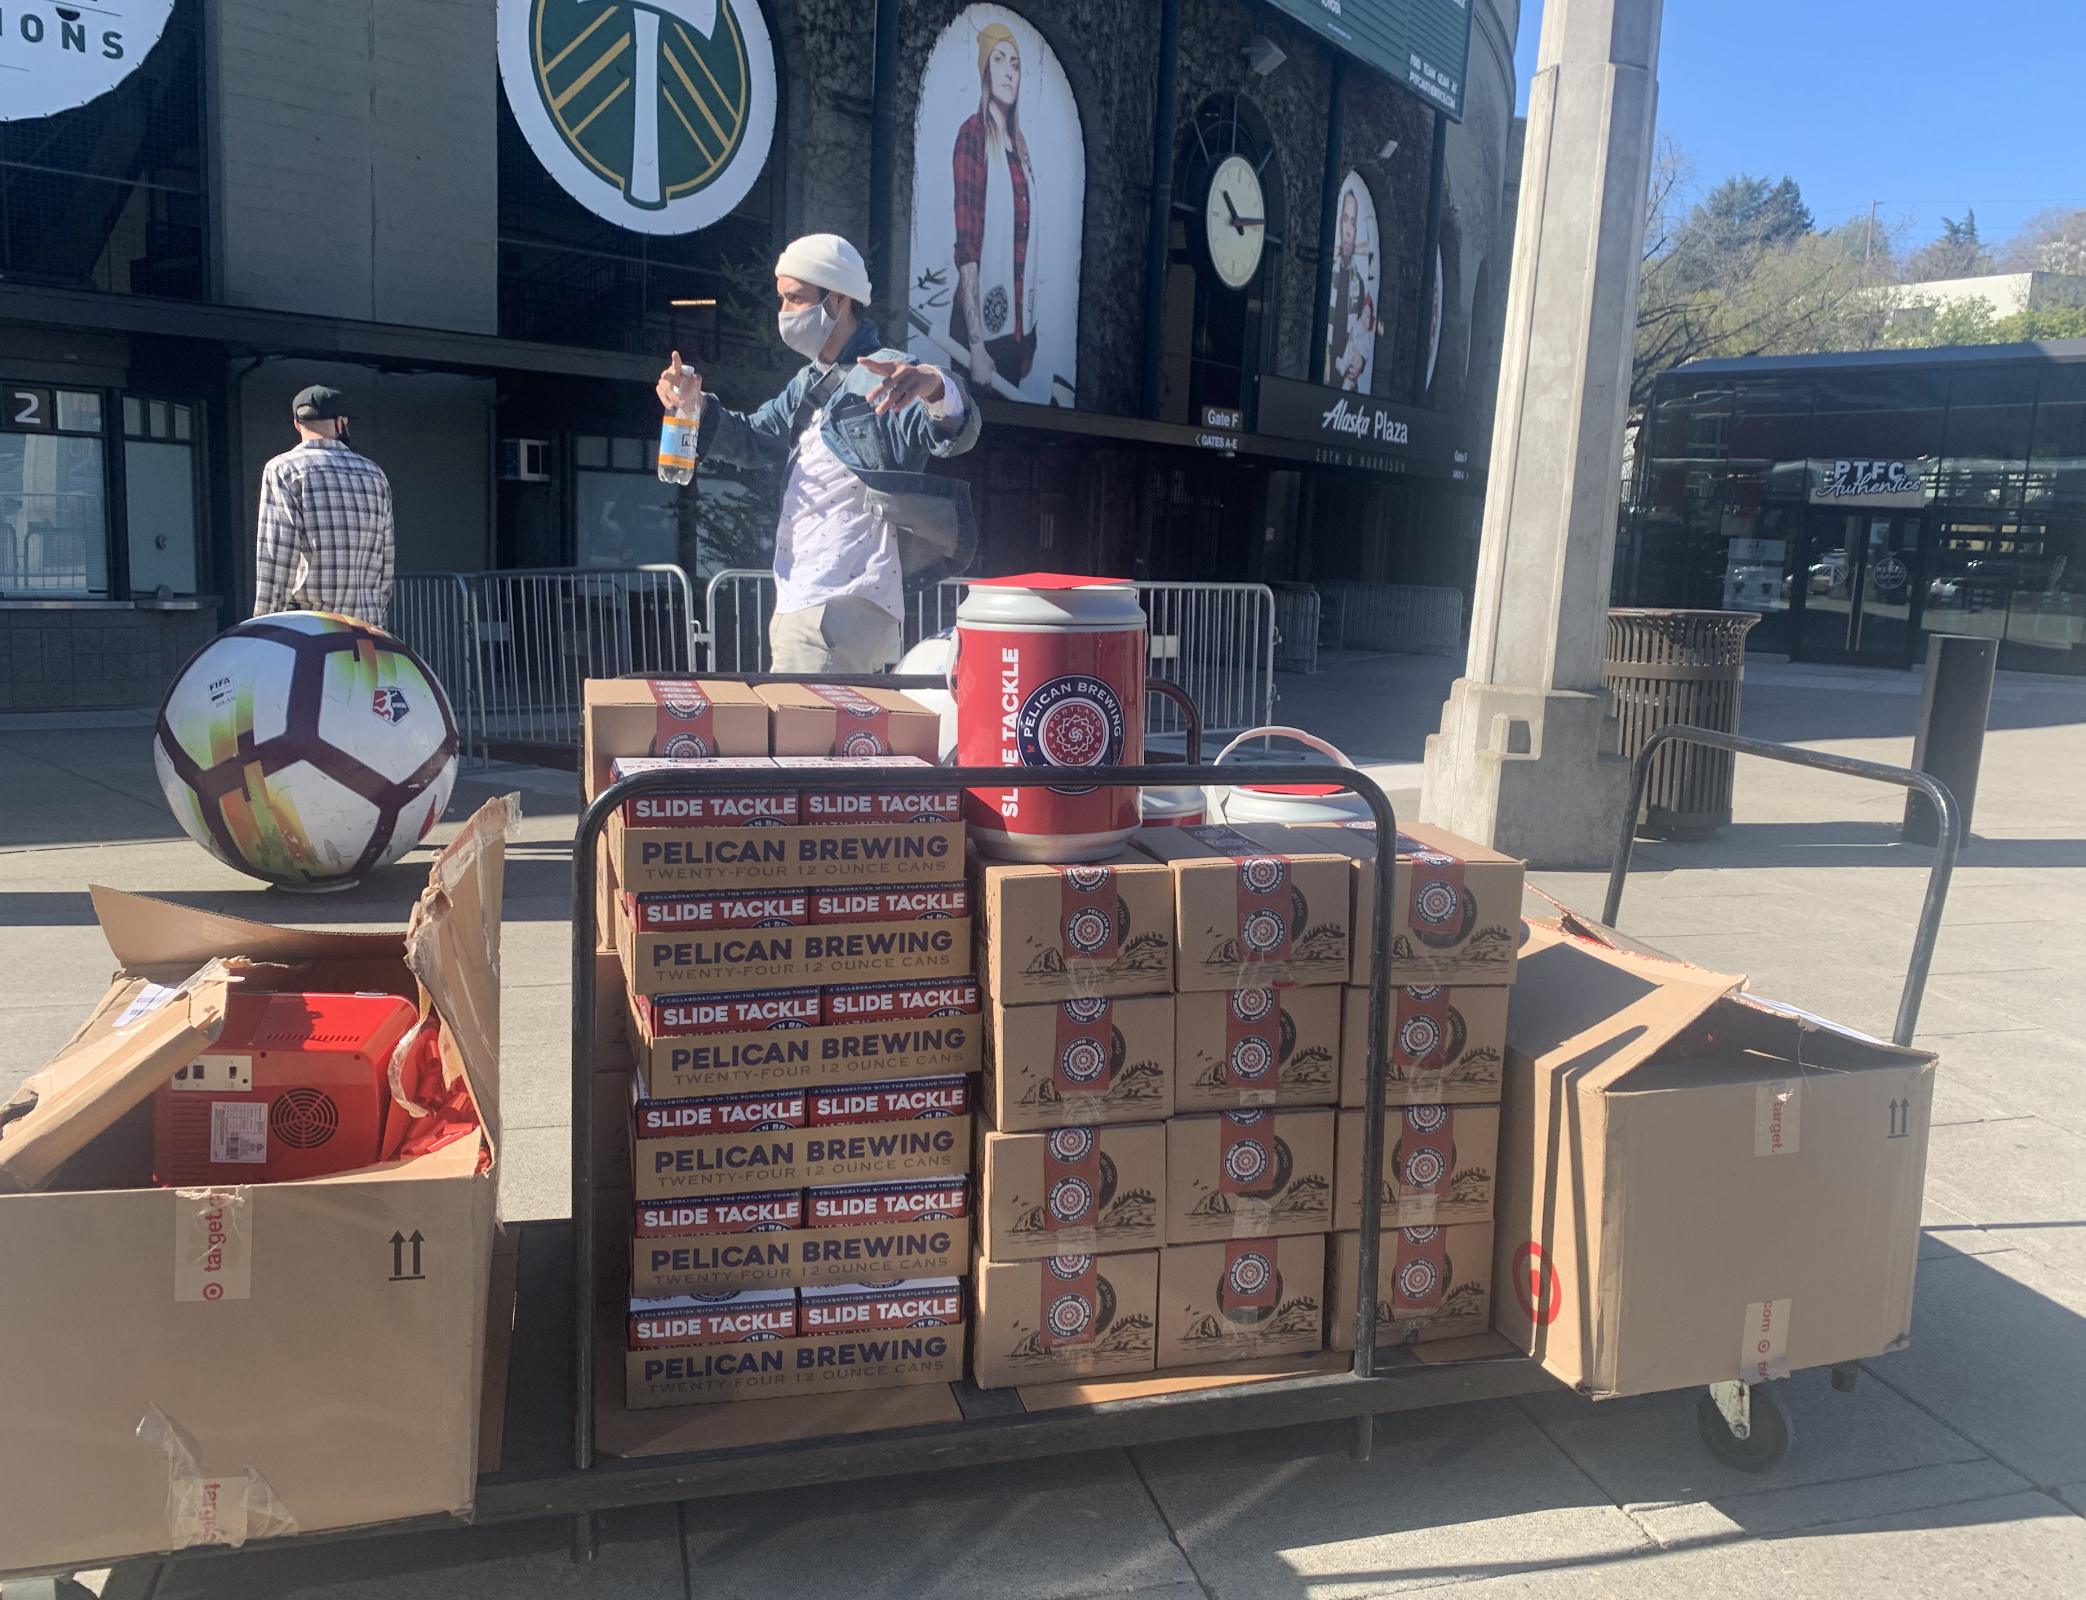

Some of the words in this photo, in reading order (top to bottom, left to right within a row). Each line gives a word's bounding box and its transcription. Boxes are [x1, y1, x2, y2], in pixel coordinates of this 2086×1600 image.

[1423, 62, 1436, 80] TEAM
[1437, 72, 1450, 89] GEAR
[15, 392, 41, 424] 2
[1207, 409, 1230, 427] Gate
[1230, 413, 1239, 428] F
[1322, 398, 1369, 439] Alaska
[1374, 411, 1408, 444] Plaza
[1201, 434, 1224, 448] GATES
[1224, 438, 1238, 449] A-E
[1316, 448, 1340, 465] 20TH
[1360, 455, 1405, 473] MORRISON
[1834, 460, 1904, 480] PTFC
[1816, 473, 1922, 497] Authentics
[210, 677, 231, 691] FIFA
[1002, 648, 1019, 741] TACKLE
[1023, 682, 1073, 738] PELICAN
[1077, 681, 1121, 737] BREWING
[1050, 706, 1101, 728] PORTLAND
[1050, 742, 1100, 764] THORNS
[1002, 749, 1019, 818] SLE
[635, 799, 702, 817] SLIDE
[710, 797, 796, 816] TACKLE
[809, 795, 872, 813] SLIDE
[878, 795, 958, 812] TACKLE
[642, 840, 785, 865] PELICAN
[798, 835, 949, 861] BREWING
[645, 866, 788, 880] TWENTY-FOUR
[798, 865, 817, 876] 12
[825, 863, 890, 875] OUNCE
[897, 861, 946, 873] CANS
[647, 903, 713, 922] SLIDE
[720, 898, 805, 918] TACKLE
[818, 896, 879, 914] SLIDE
[885, 892, 965, 911] TACKLE
[653, 938, 792, 967] PELICAN
[805, 930, 953, 958] BREWING
[656, 964, 794, 981] TWENTY-FOUR
[804, 962, 823, 973] 12
[831, 958, 895, 971] OUNCE
[902, 955, 950, 967] CANS
[664, 1005, 729, 1026] SLIDE
[735, 999, 818, 1021] TACKLE
[832, 993, 893, 1013] SLIDE
[899, 988, 976, 1009] TACKLE
[671, 1039, 809, 1072] PELICAN
[821, 1027, 966, 1060] BREWING
[674, 1065, 811, 1086] TWENTY-FOUR
[821, 1062, 839, 1074] 12
[847, 1057, 909, 1071] OUNCE
[916, 1052, 963, 1066] CANS
[646, 1108, 711, 1128] SLIDE
[719, 1100, 803, 1123] TACKLE
[817, 1096, 879, 1115] SLIDE
[884, 1089, 964, 1111] TACKLE
[655, 1142, 794, 1174] PELICAN
[806, 1130, 954, 1162] BREWING
[657, 1168, 795, 1188] TWENTY-FOUR
[806, 1165, 825, 1176] 12
[832, 1159, 896, 1174] OUNCE
[903, 1155, 951, 1168] CANS
[644, 1207, 708, 1227] SLIDE
[715, 1201, 799, 1223] TACKLE
[815, 1198, 877, 1217] SLIDE
[884, 1191, 963, 1213] TACKLE
[651, 1243, 789, 1272] PELICAN
[802, 1232, 951, 1263] BREWING
[654, 1267, 792, 1286] TWENTY-FOUR
[801, 1266, 820, 1277] 12
[828, 1261, 893, 1274] OUNCE
[900, 1257, 948, 1270] CANS
[637, 1319, 702, 1339] SLIDE
[708, 1311, 793, 1334] TACKLE
[808, 1305, 870, 1325] SLIDE
[877, 1298, 957, 1319] TACKLE
[1761, 1300, 1773, 1333] com
[645, 1350, 783, 1381] PELICAN
[796, 1336, 947, 1369] BREWING
[649, 1374, 786, 1394] TWENTY-FOUR
[796, 1372, 815, 1382] 12
[823, 1366, 888, 1380] OUNCE
[895, 1360, 944, 1374] CANS
